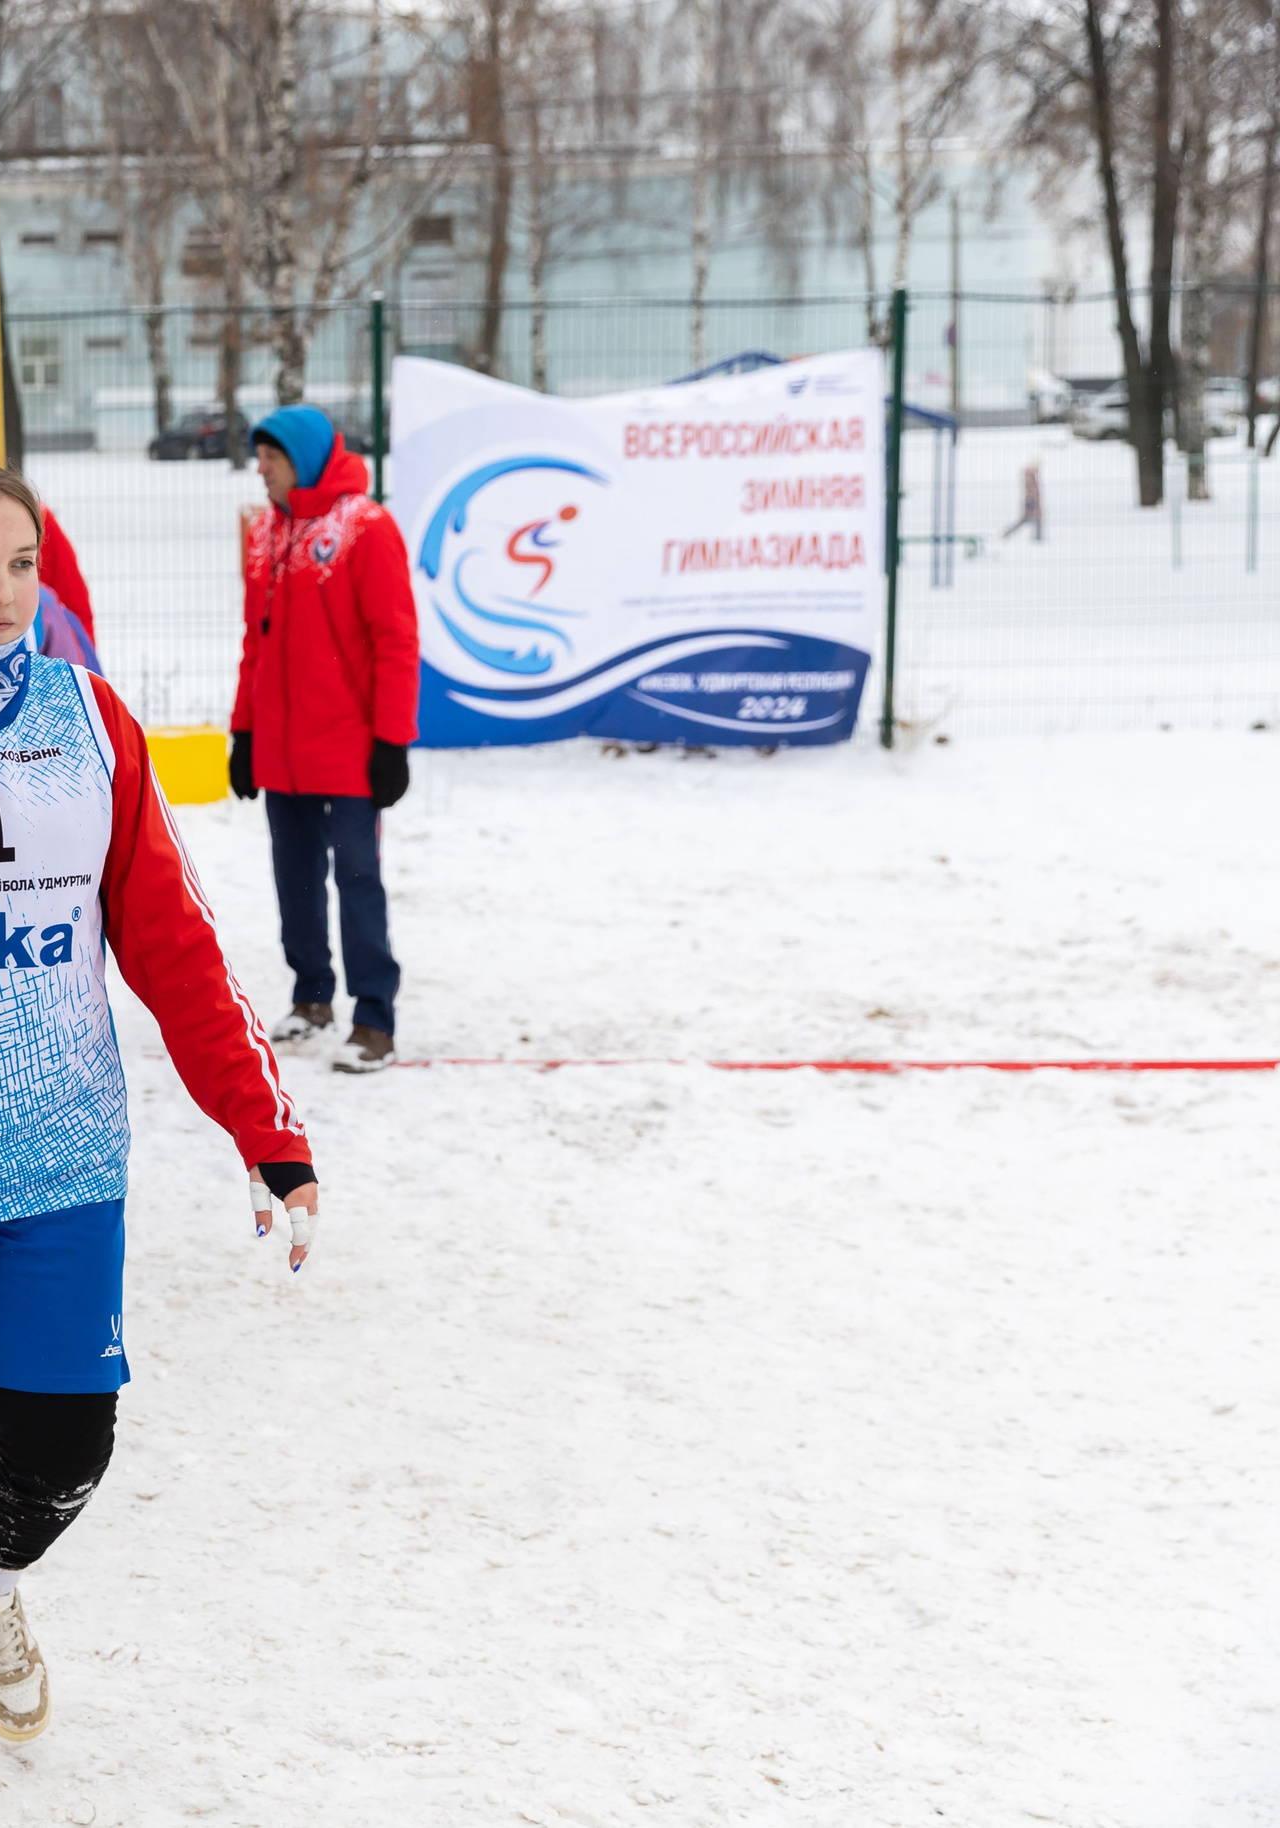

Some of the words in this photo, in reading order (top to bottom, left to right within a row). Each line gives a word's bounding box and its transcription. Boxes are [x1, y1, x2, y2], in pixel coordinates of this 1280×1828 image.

[623, 413, 867, 459] ВСЕРОССИЙСКАЯ
[740, 474, 867, 515] ЗИМНЯЯ
[661, 532, 867, 576] ГИМНАЗИАДА
[736, 695, 808, 720] 2024
[38, 874, 92, 891] УДМУРТИИ
